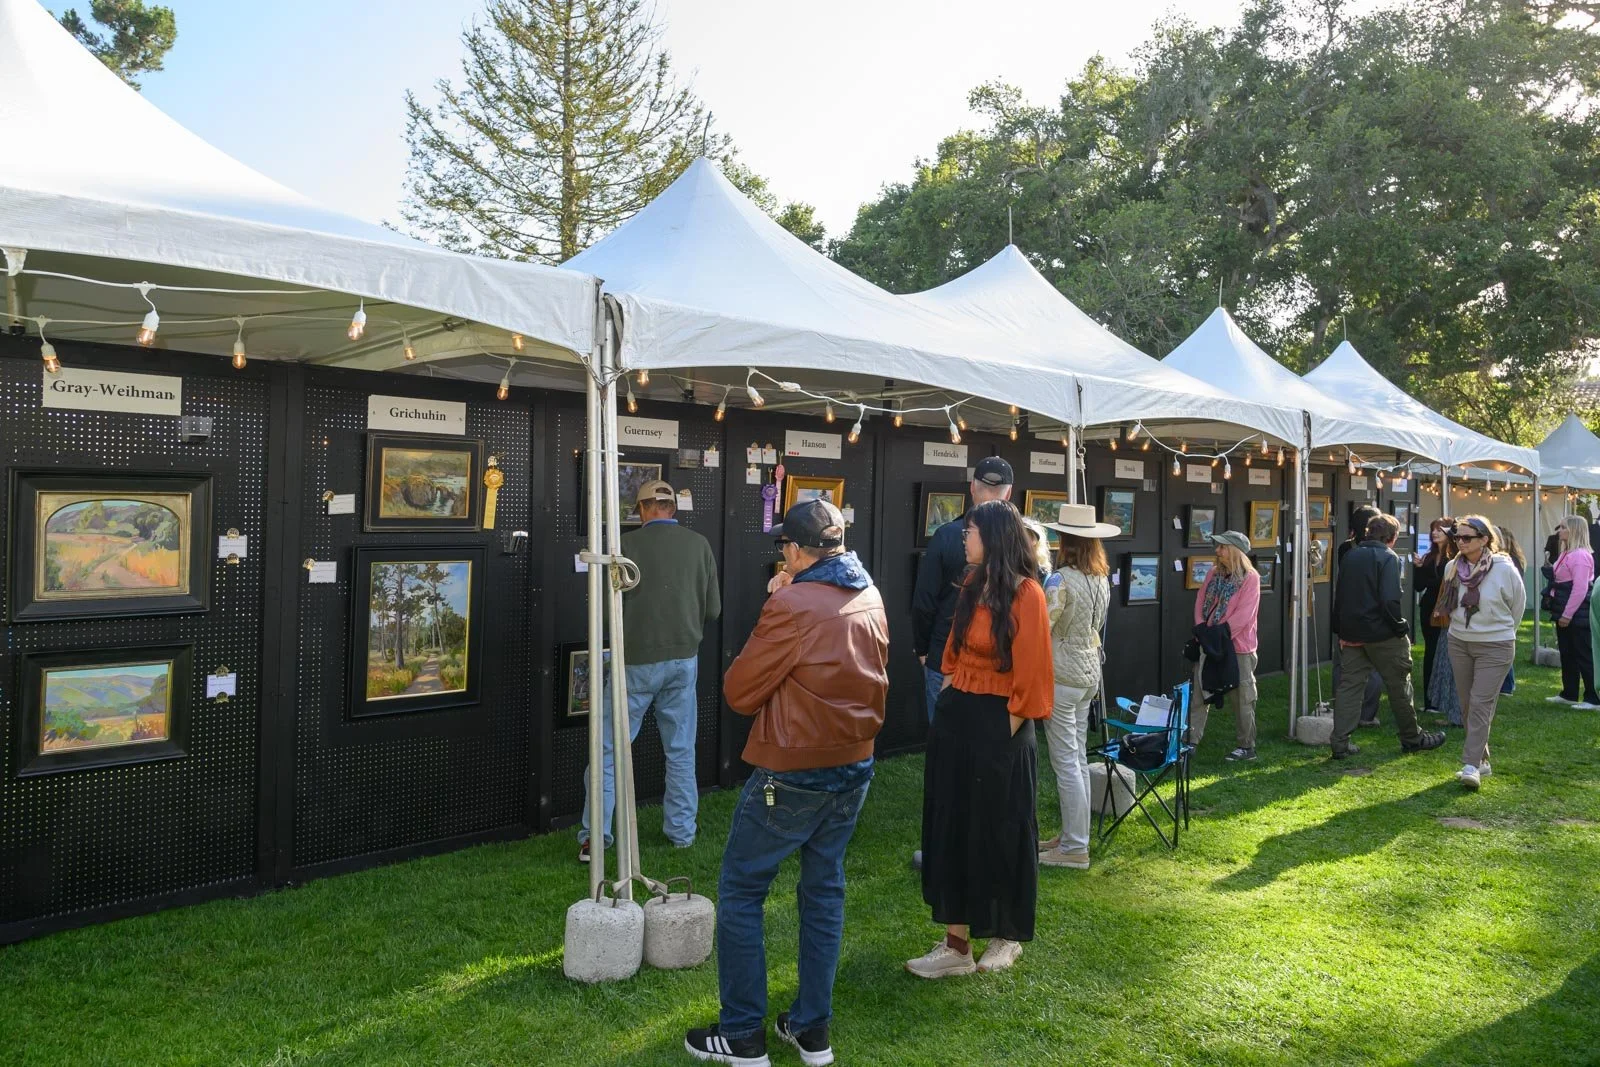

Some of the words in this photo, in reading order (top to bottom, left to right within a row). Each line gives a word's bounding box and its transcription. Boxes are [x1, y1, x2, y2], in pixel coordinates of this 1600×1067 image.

[52, 379, 174, 400] Gray-Weihman
[389, 407, 447, 421] Grichuhin
[624, 425, 663, 439] Guernsey
[801, 439, 827, 449] Hanson
